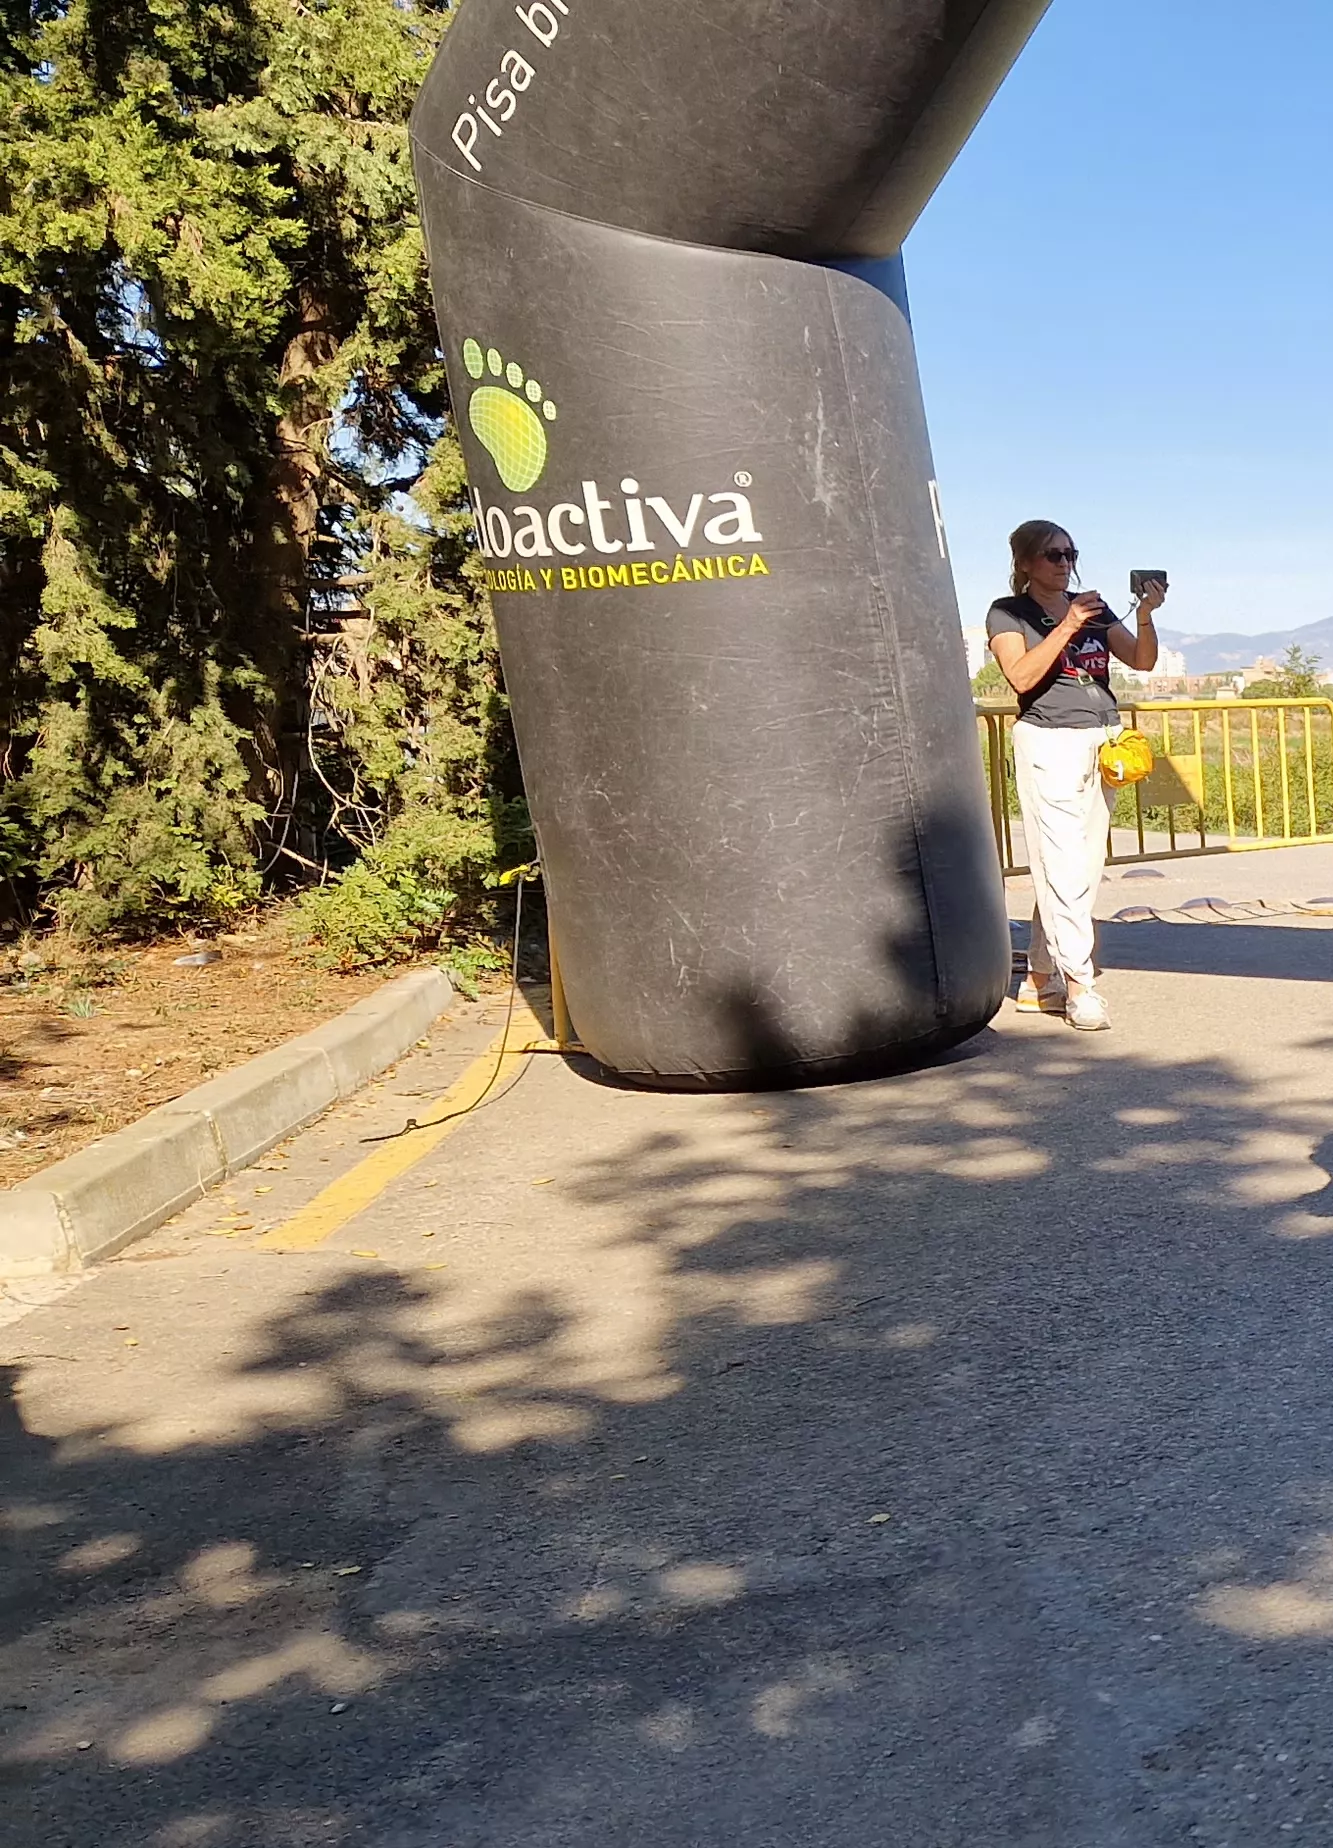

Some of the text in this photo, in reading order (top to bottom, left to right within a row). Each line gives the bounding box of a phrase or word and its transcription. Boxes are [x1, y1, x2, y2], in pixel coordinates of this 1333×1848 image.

[451, 50, 537, 172] Pisa
[484, 553, 769, 592] OLOGÍA Y BIOMECÁNICA
